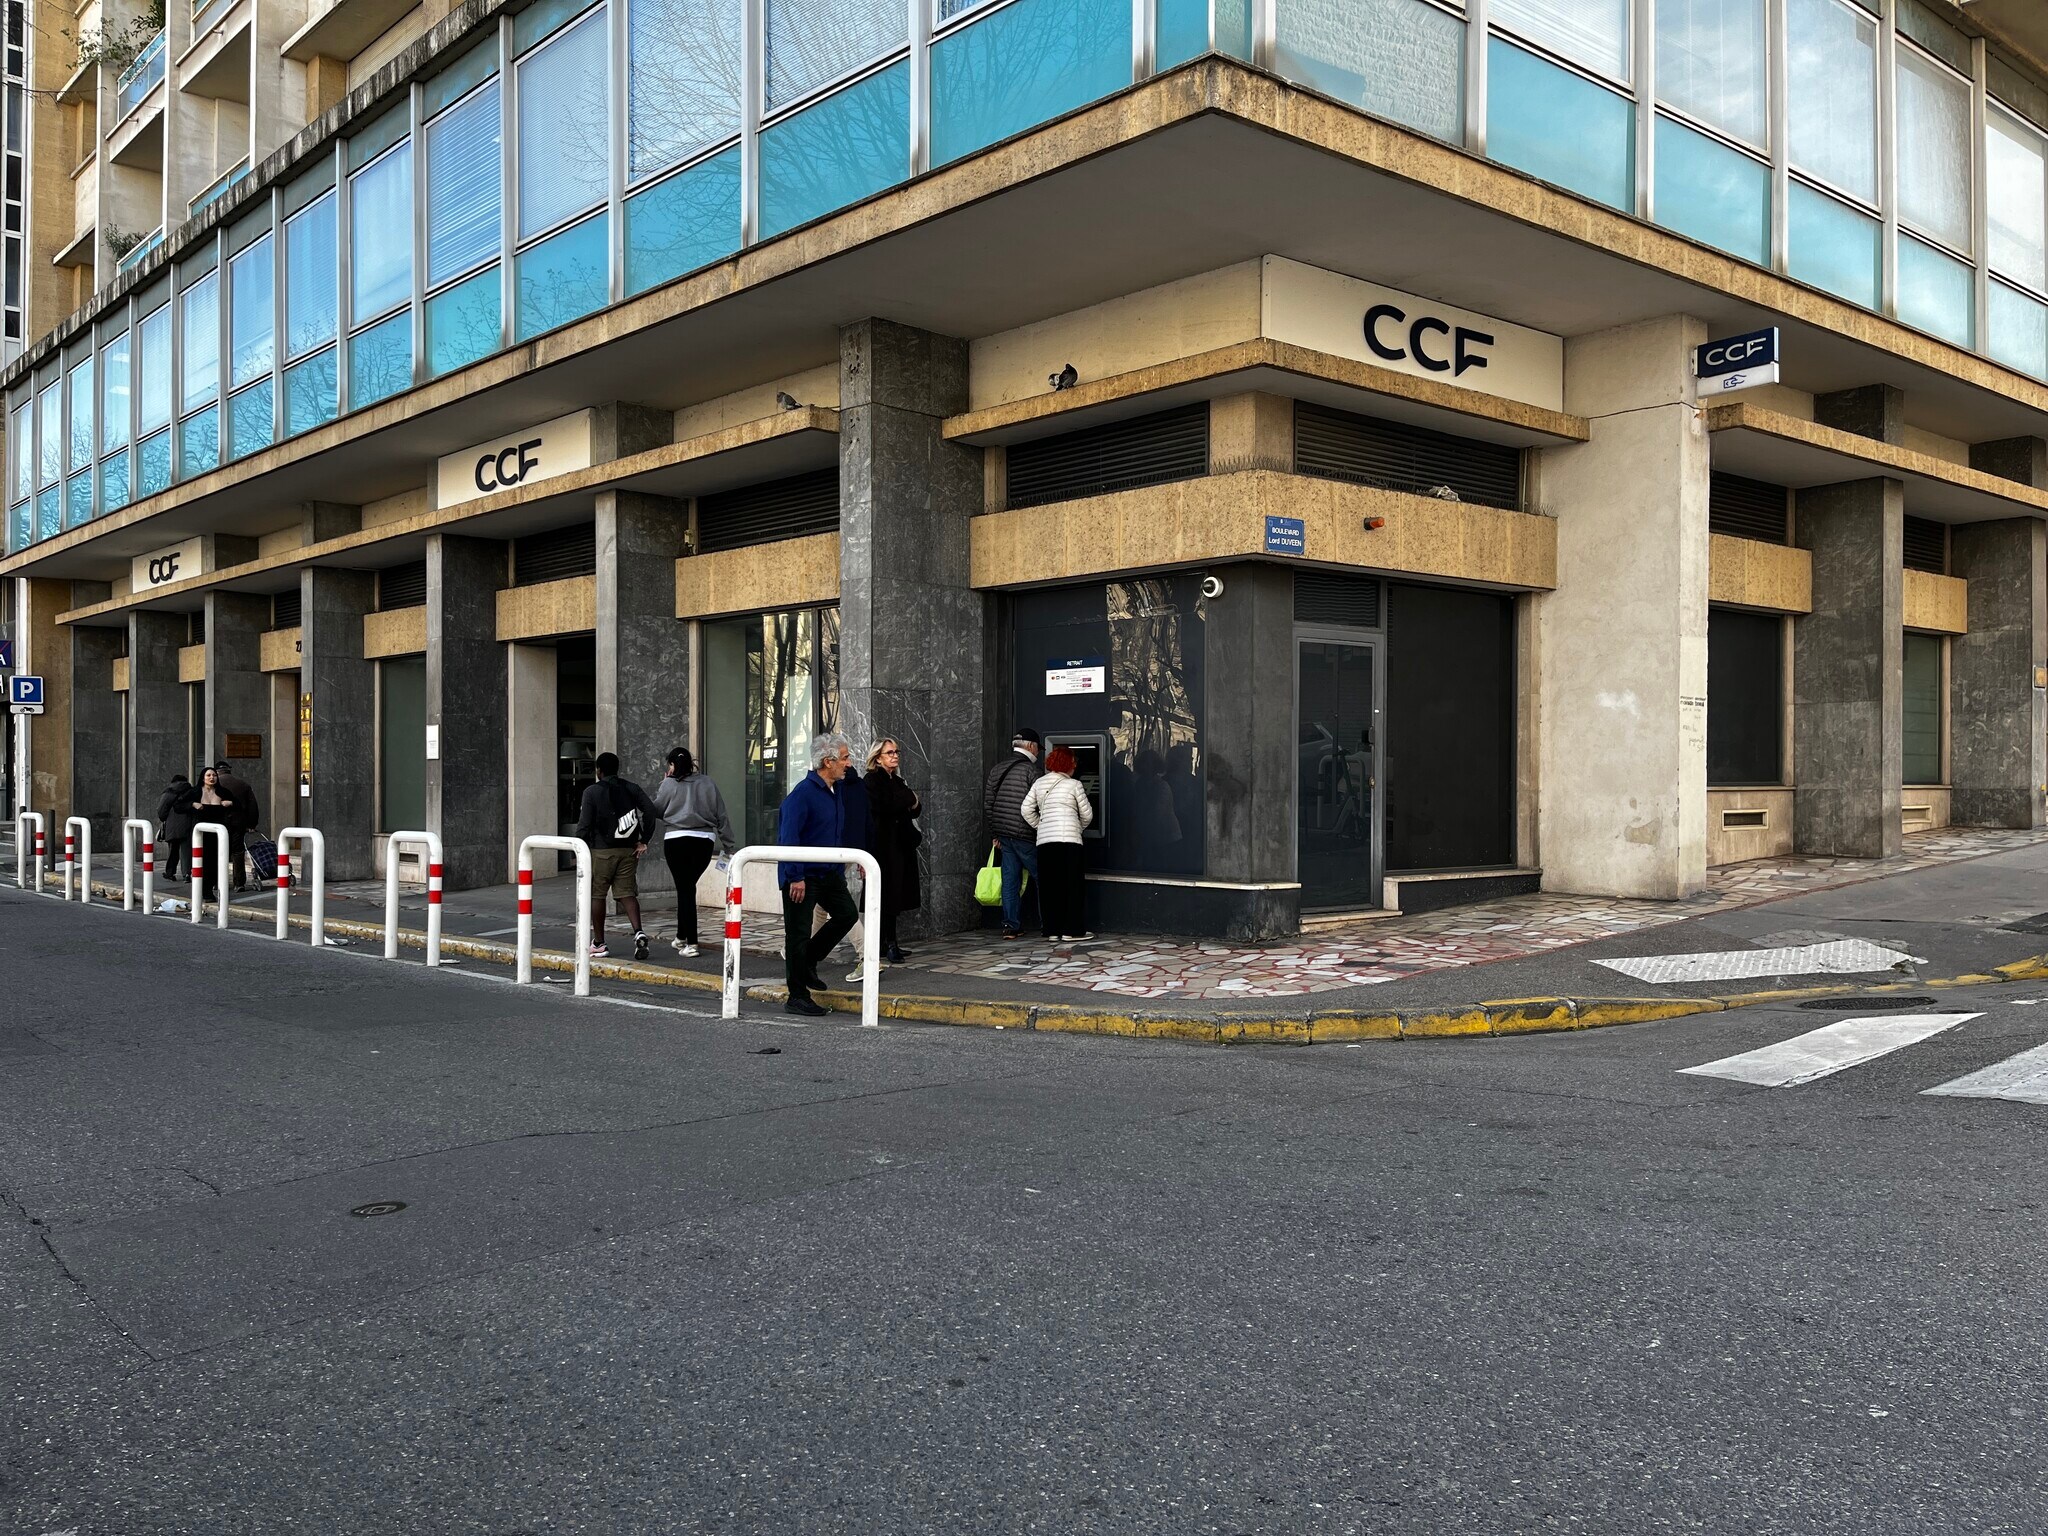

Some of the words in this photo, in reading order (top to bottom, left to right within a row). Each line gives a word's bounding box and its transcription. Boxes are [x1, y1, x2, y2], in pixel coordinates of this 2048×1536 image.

[1363, 304, 1494, 377] CCF
[1705, 337, 1767, 366] CCF
[475, 438, 542, 492] CCF
[1268, 537, 1280, 545] Lord
[1281, 538, 1302, 547] DUVEEN
[1271, 527, 1300, 536] BOULEVARD
[150, 552, 180, 584] CCF
[20, 681, 34, 699] P
[618, 808, 638, 832] NIKE
